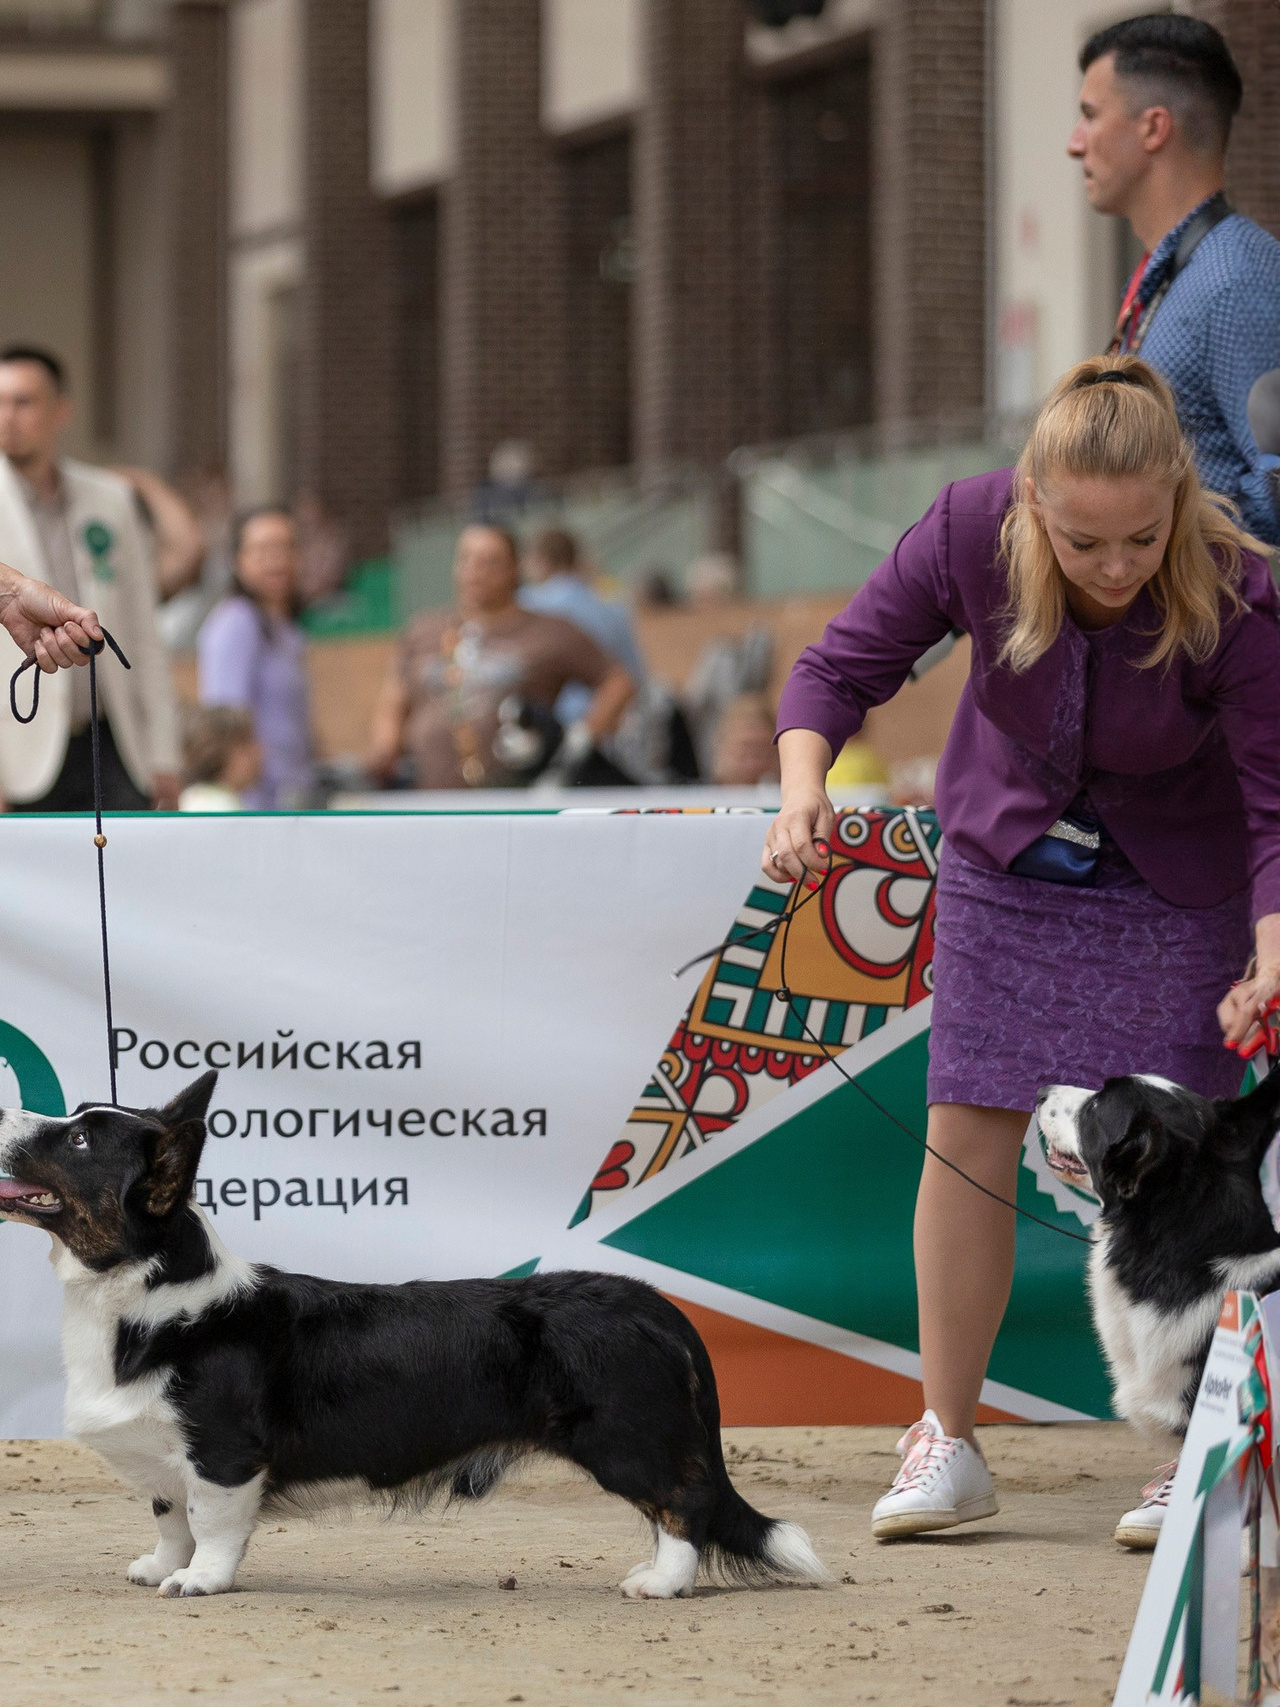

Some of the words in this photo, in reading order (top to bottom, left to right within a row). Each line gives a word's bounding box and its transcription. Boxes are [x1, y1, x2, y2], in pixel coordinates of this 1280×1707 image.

[112, 1028, 422, 1070] Российская
[207, 1108, 547, 1139] ологическая
[194, 1177, 409, 1221] дерация
